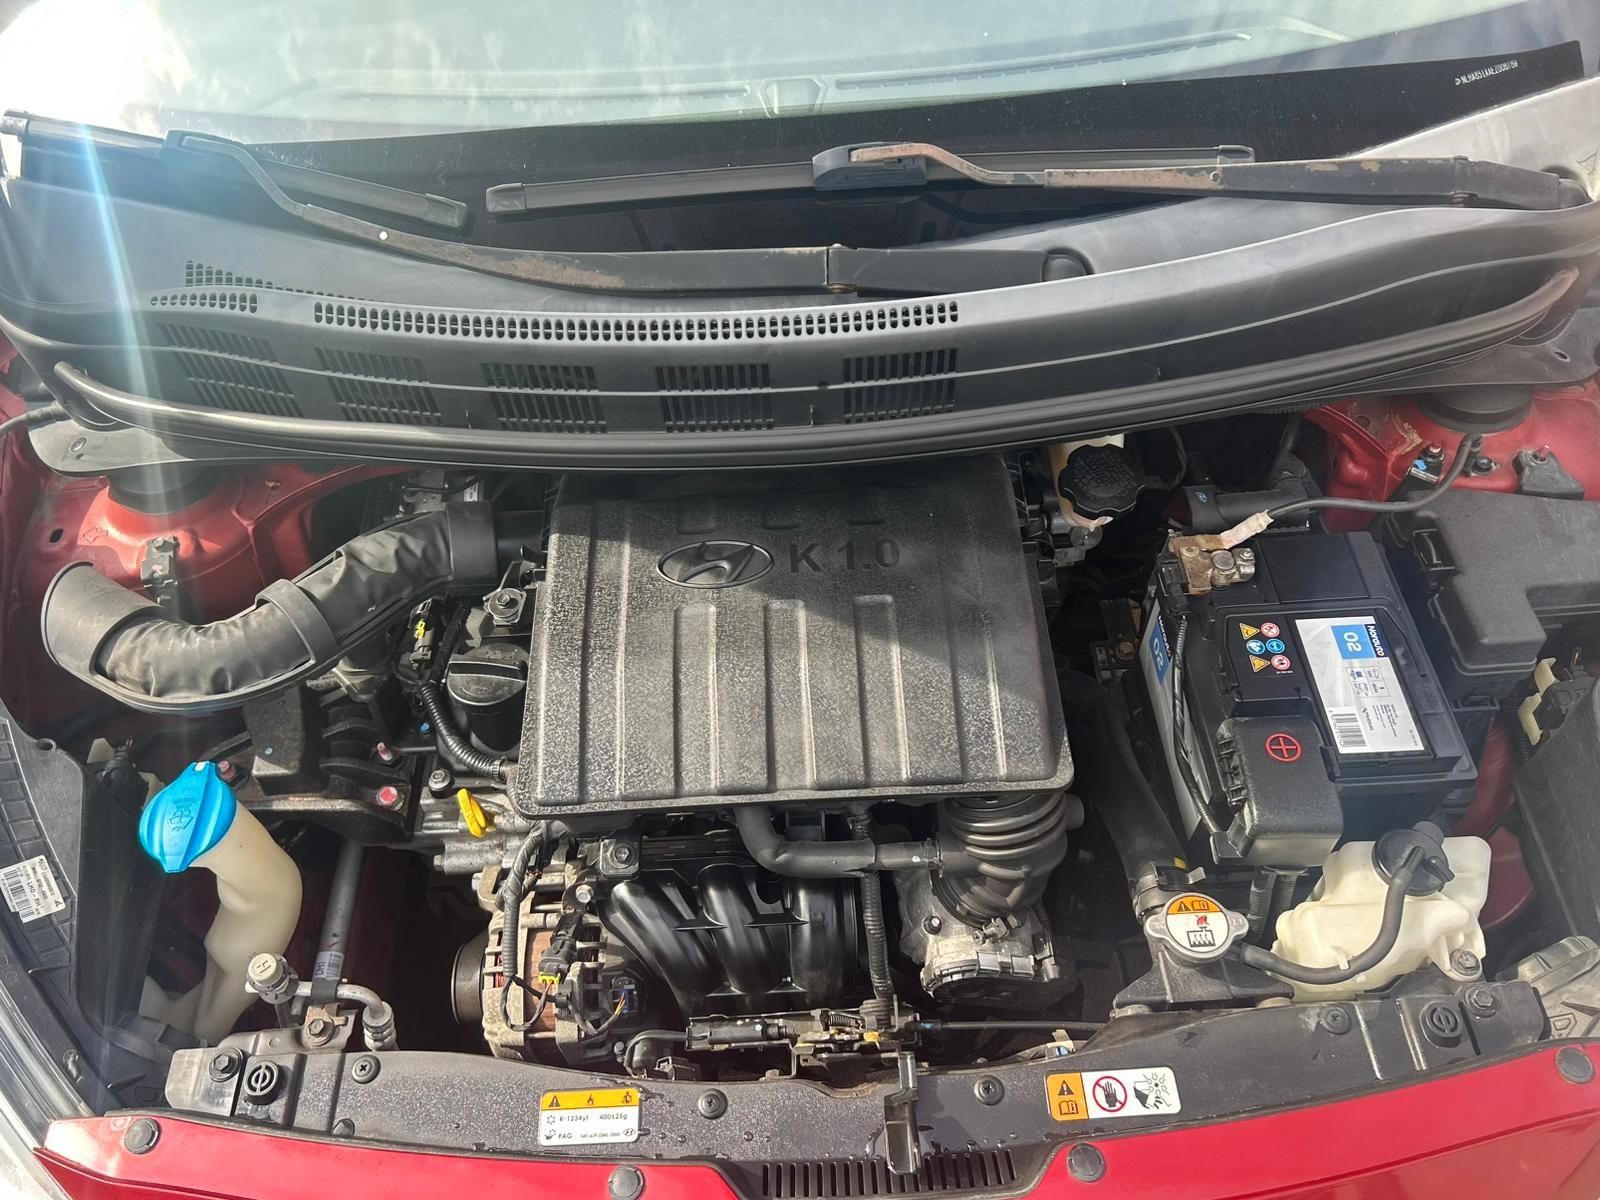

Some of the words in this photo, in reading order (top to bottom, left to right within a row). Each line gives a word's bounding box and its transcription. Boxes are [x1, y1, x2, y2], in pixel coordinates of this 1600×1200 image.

[790, 542, 823, 573] K
[837, 540, 900, 570] 1.0
[1153, 638, 1163, 671] 02
[1343, 631, 1362, 652] 02
[1367, 625, 1385, 657] Norauto
